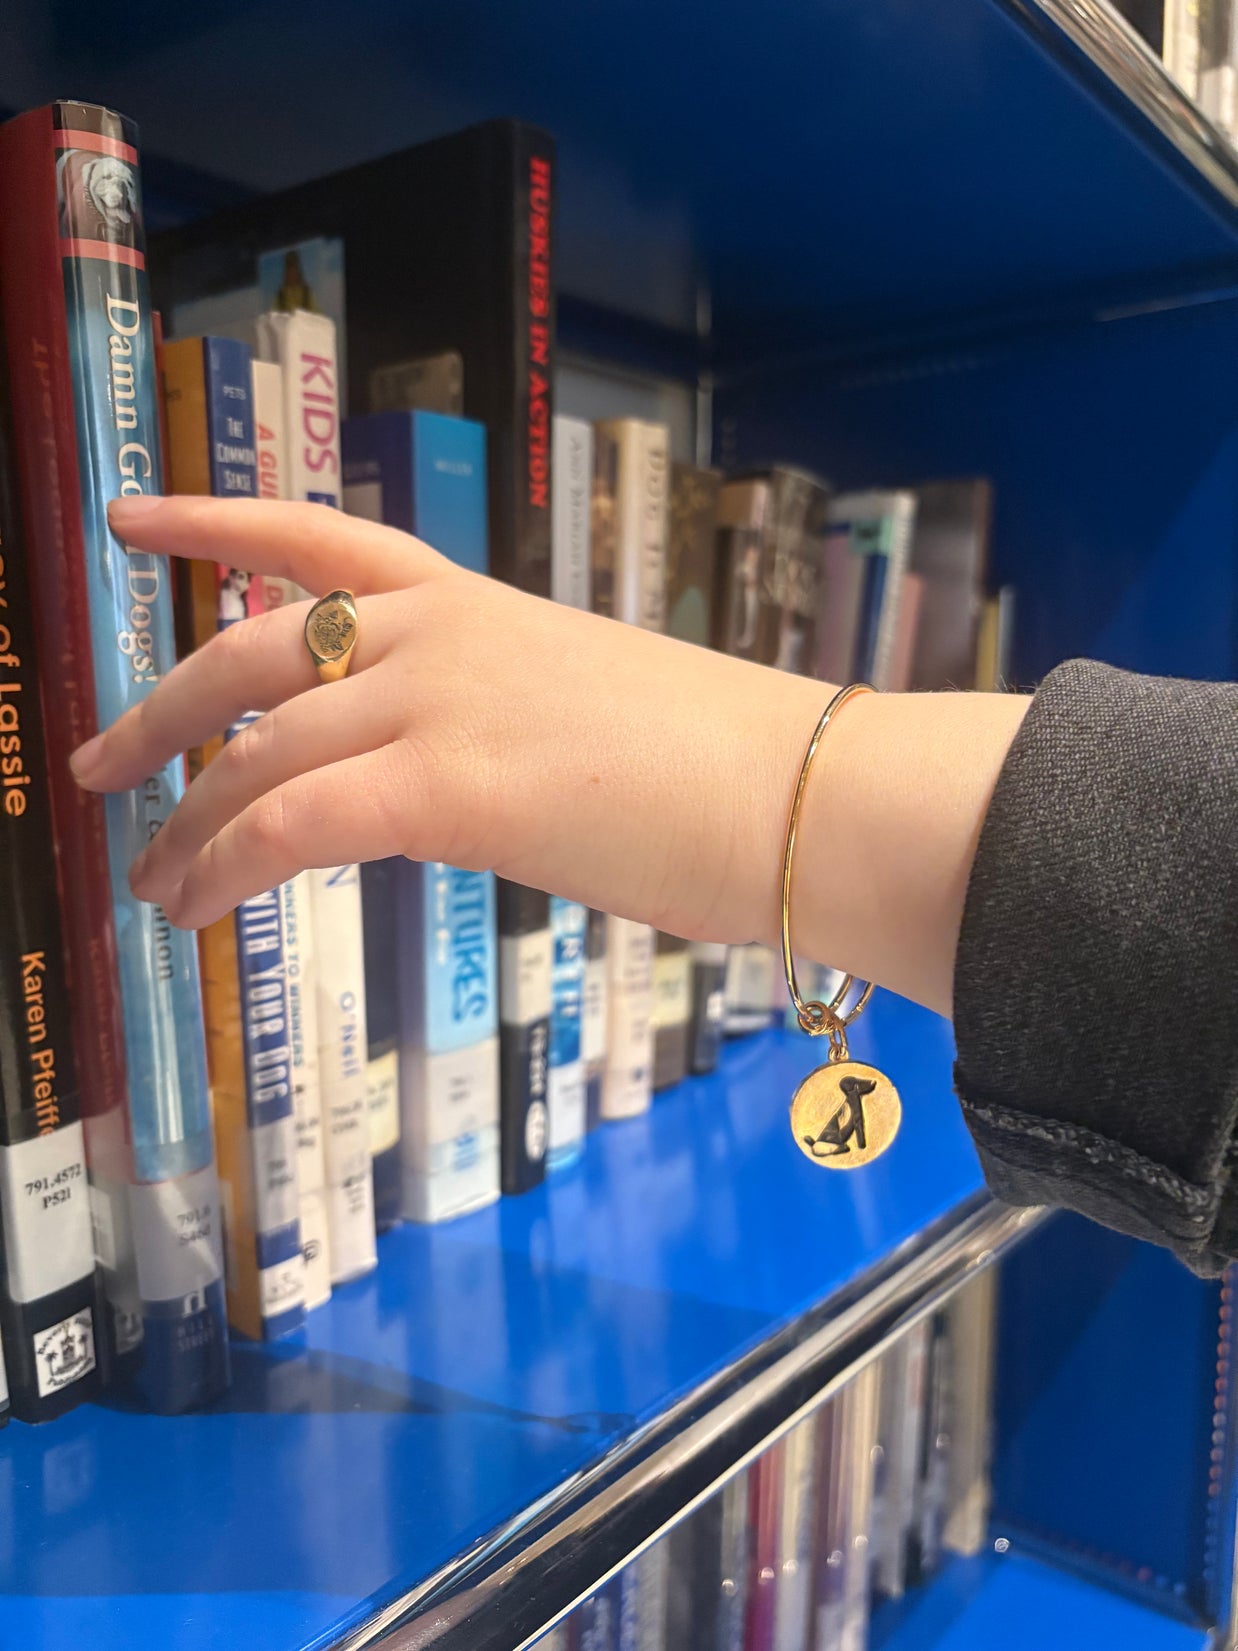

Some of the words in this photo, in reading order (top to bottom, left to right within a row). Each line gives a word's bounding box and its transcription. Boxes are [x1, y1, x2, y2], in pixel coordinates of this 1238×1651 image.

[529, 156, 551, 318] HUSKIES
[106, 293, 141, 431] Damn
[529, 323, 549, 365] IN
[258, 423, 276, 441] A
[301, 354, 337, 475] KIDS
[529, 370, 549, 509] ACTION
[0, 624, 20, 668] of
[117, 555, 160, 684] Dogs!
[0, 683, 31, 817] Lassie
[21, 951, 47, 1044] Karen
[249, 963, 286, 1039] YOUR
[253, 1046, 290, 1104] DOG
[24, 1162, 82, 1197] 791.4572
[42, 1186, 72, 1210] P521
